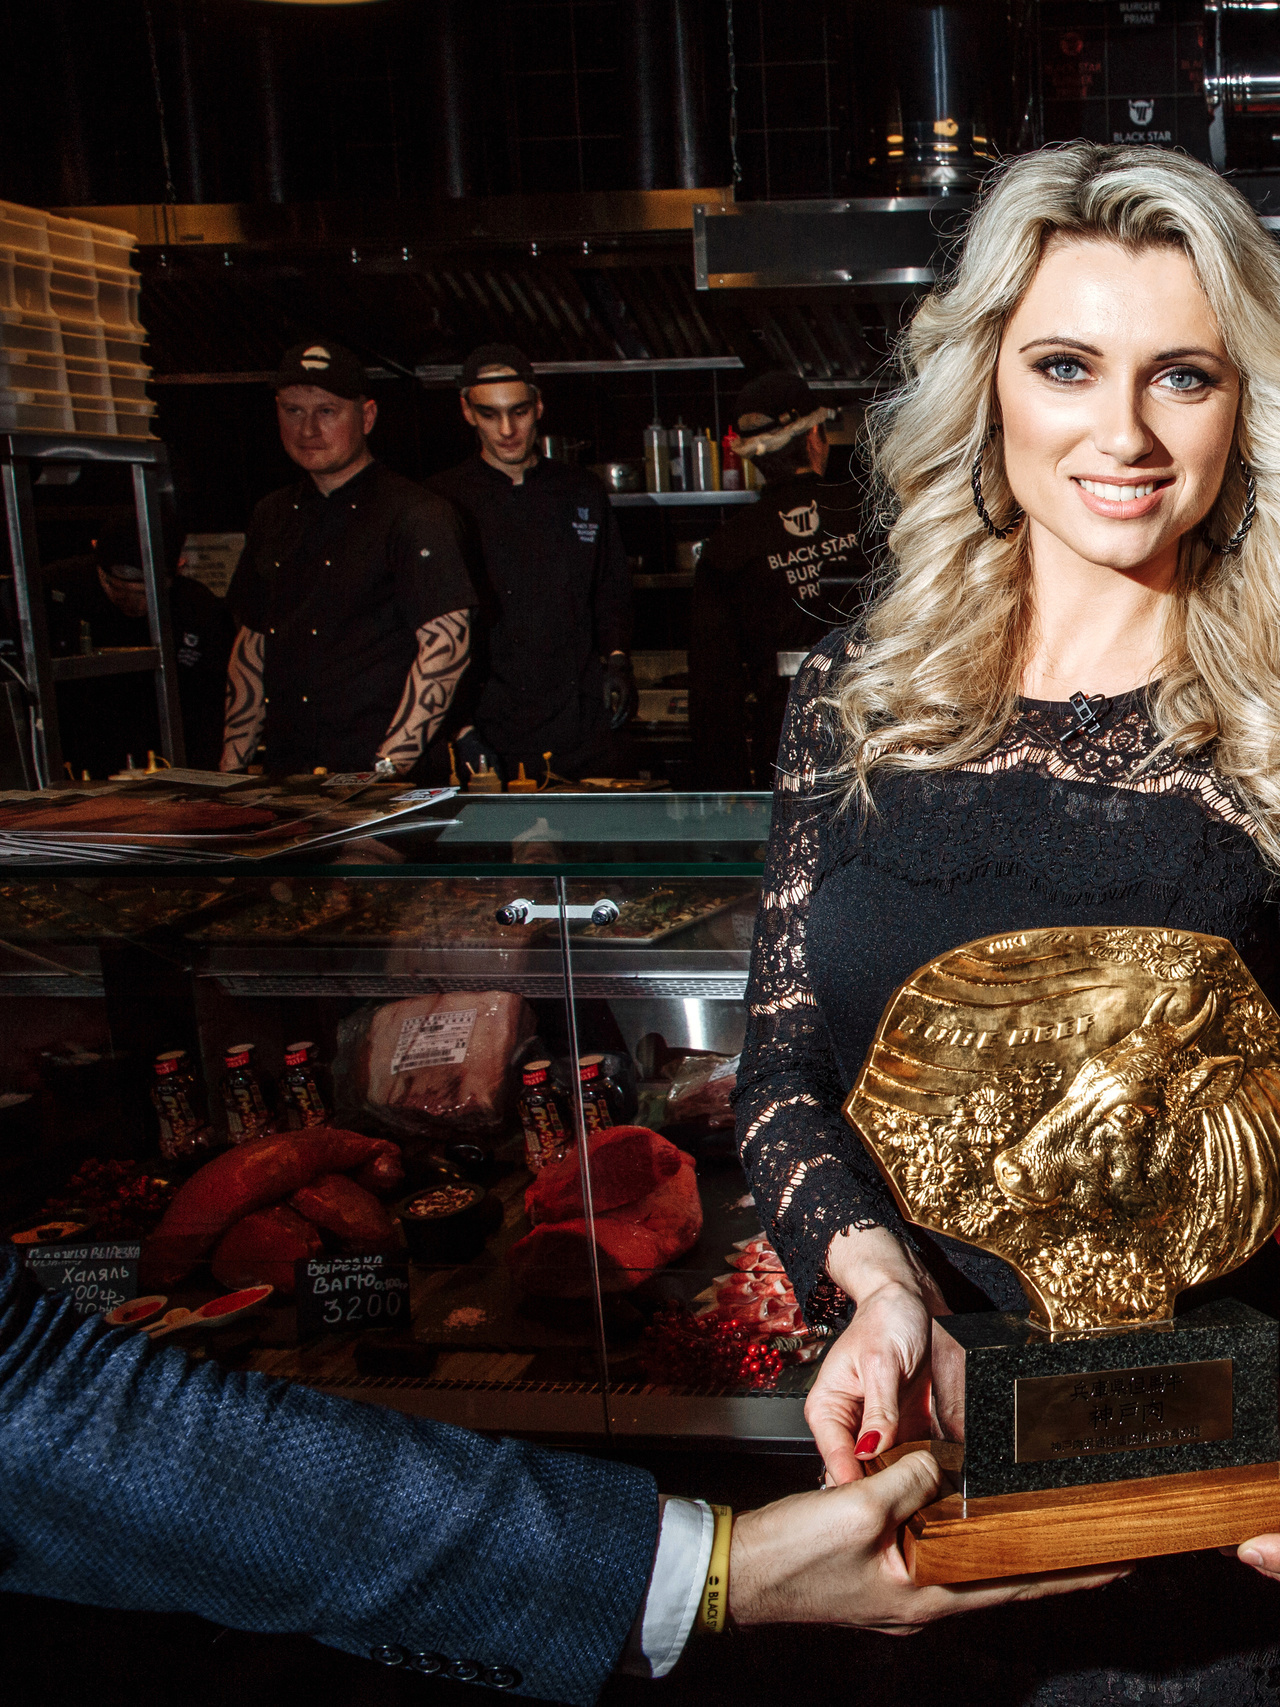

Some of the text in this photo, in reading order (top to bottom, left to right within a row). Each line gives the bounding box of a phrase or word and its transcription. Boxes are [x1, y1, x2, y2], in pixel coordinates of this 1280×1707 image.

[1113, 130, 1172, 143] BLACK STAR
[767, 533, 860, 570] BLACK STAR
[798, 581, 820, 600] PRI
[898, 1012, 1096, 1049] KOBE BEEF
[312, 1272, 377, 1295] ВАГЮ
[322, 1291, 402, 1324] 3200
[1088, 1399, 1165, 1430] 神戸肉
[706, 1591, 719, 1620] BLACK
